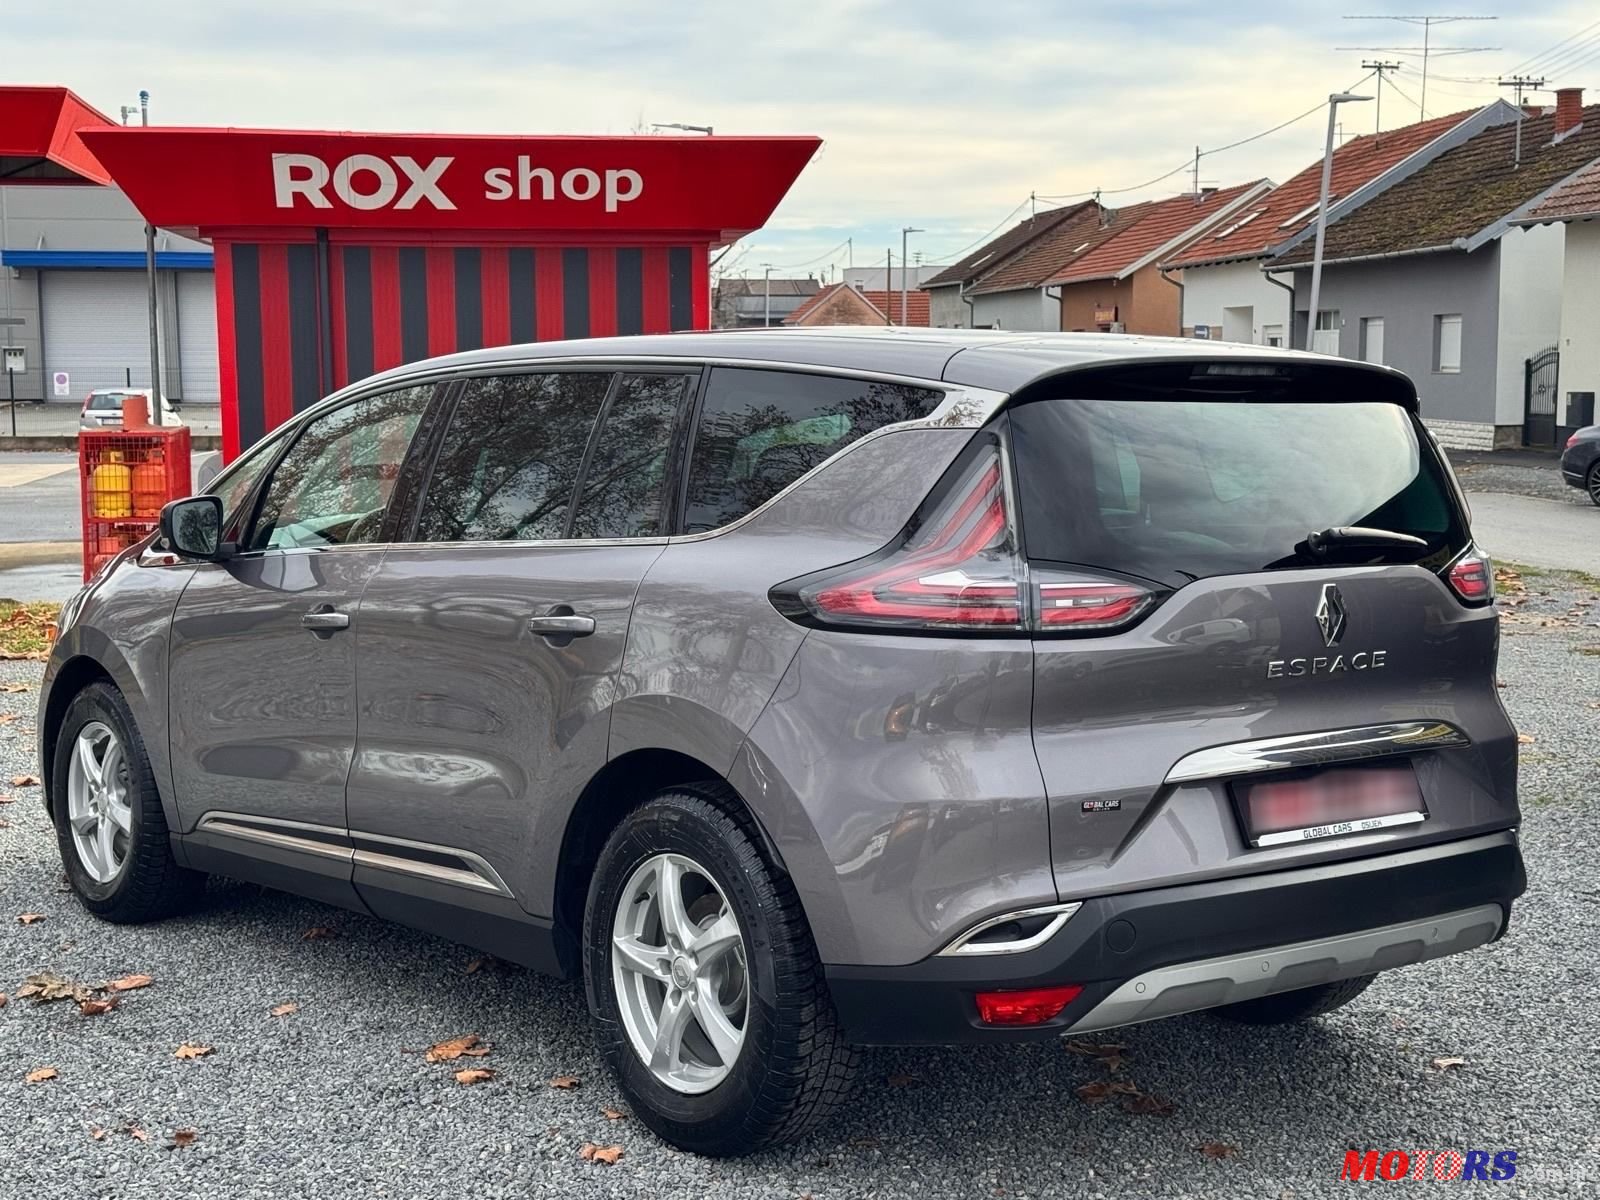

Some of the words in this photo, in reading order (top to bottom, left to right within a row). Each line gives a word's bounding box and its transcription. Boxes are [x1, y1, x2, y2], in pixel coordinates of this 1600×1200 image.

[271, 152, 459, 211] ROX
[484, 155, 644, 213] shop
[1267, 650, 1387, 679] ESPACE
[1104, 800, 1119, 808] CARS
[1303, 826, 1332, 839] GLOBAL
[1333, 823, 1353, 834] CARS
